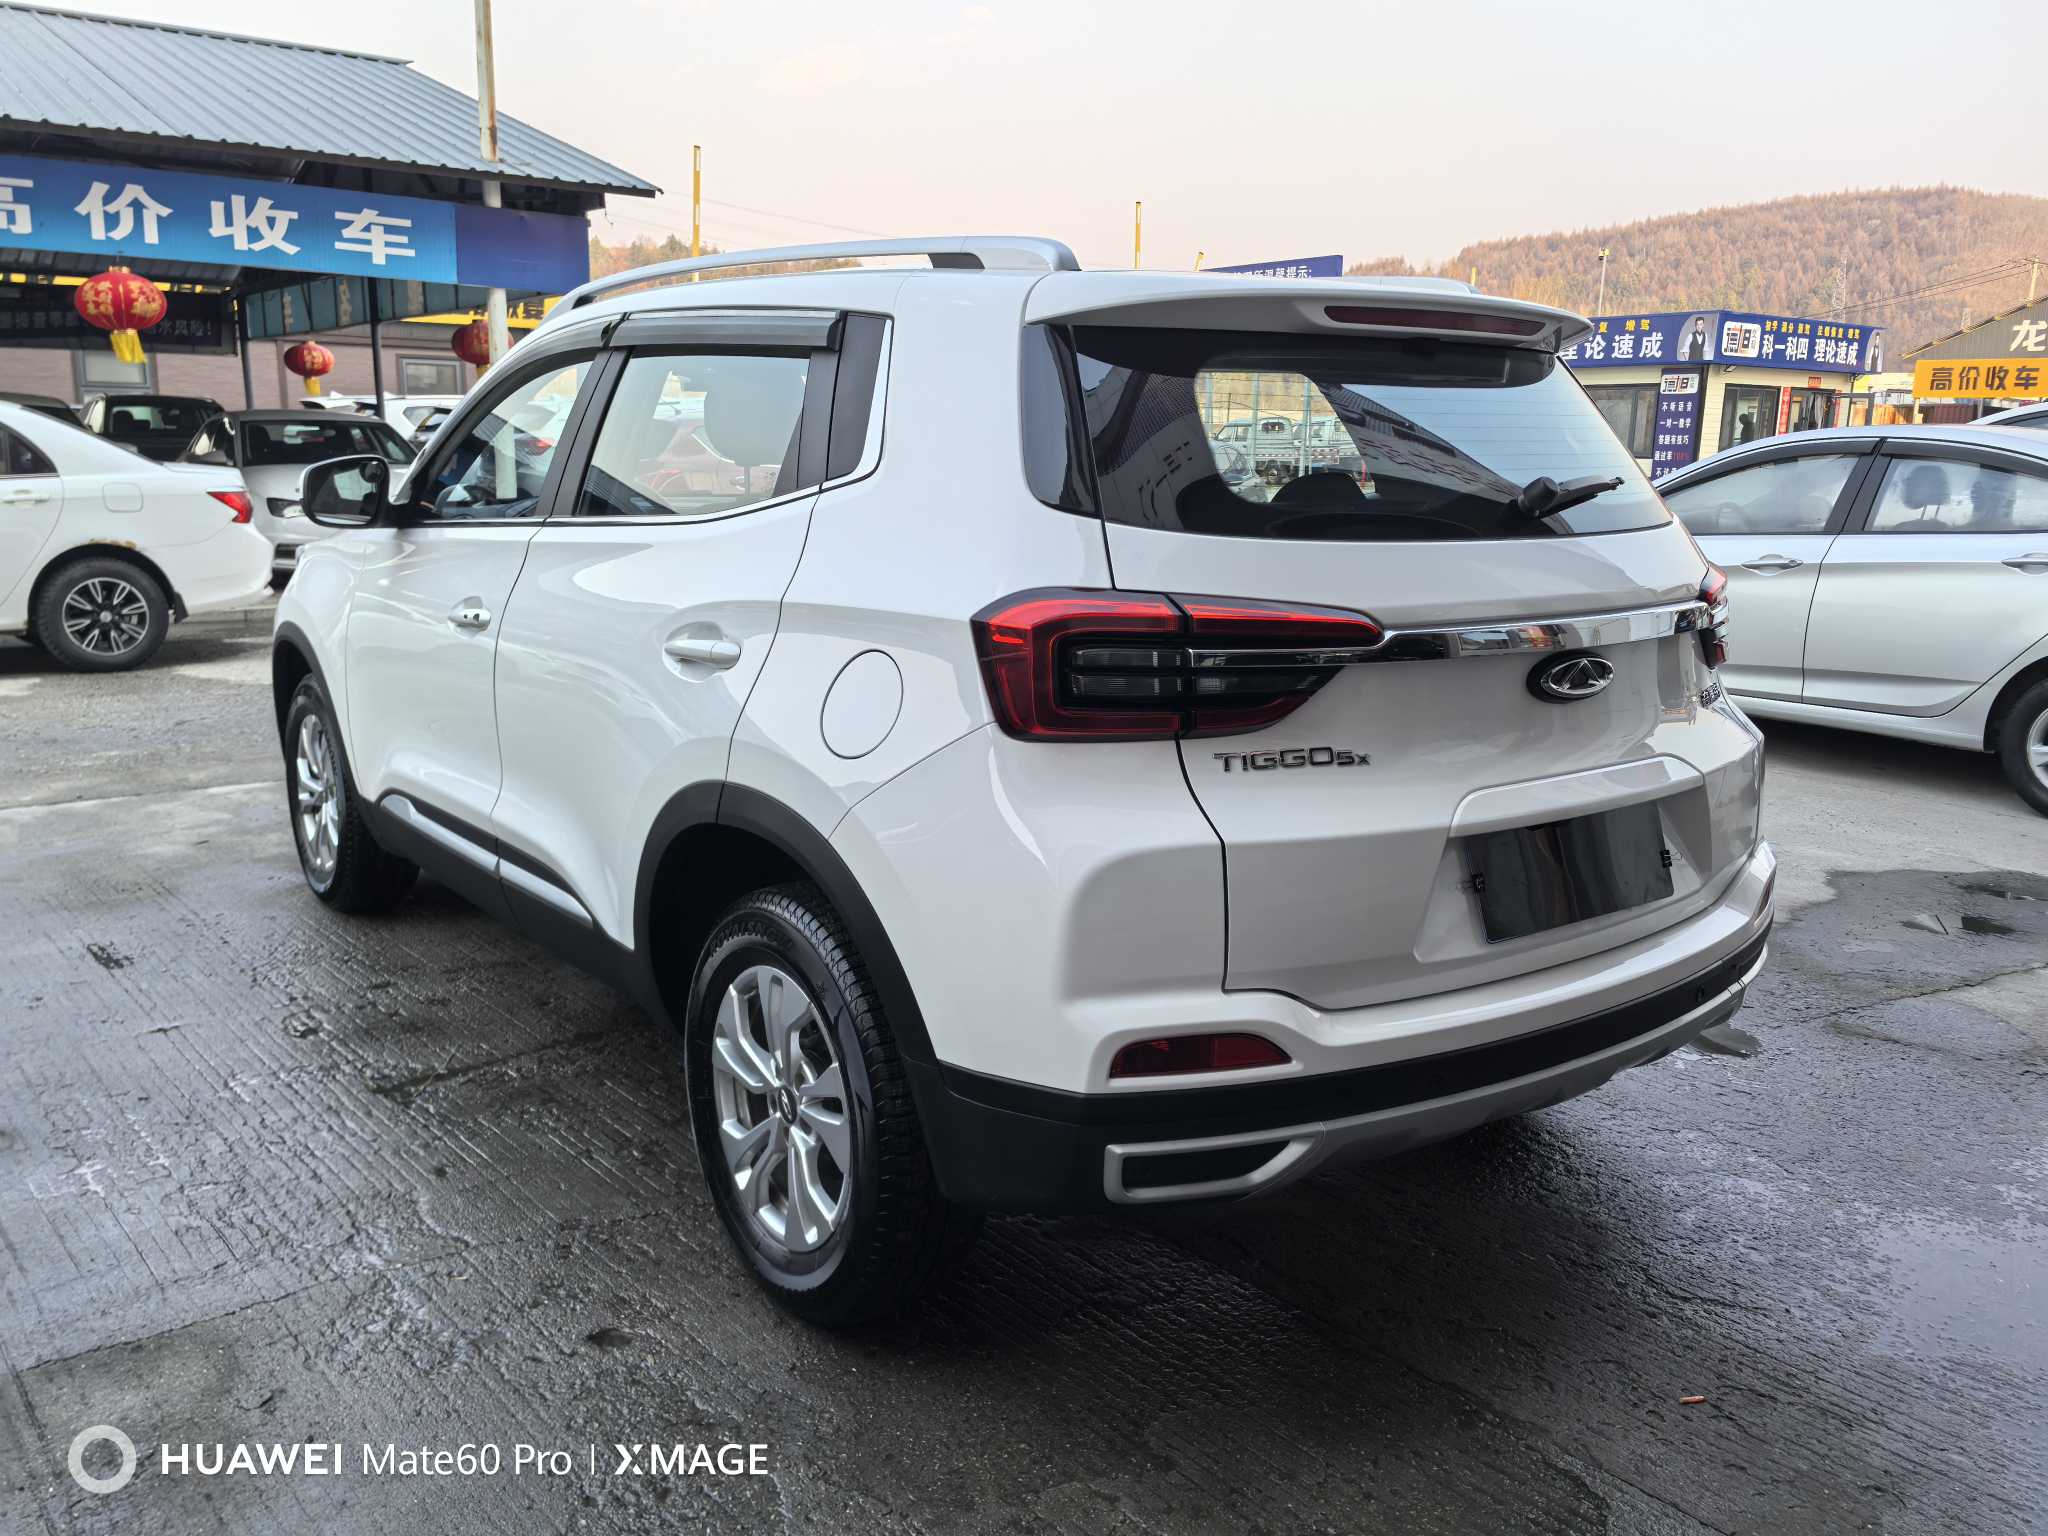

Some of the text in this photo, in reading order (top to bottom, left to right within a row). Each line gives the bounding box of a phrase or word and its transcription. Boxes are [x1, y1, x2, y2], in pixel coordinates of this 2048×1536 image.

[1762, 334, 1810, 361] 科一科四
[1814, 338, 1860, 366] 理论速成
[1930, 366, 2040, 391] 高价收车
